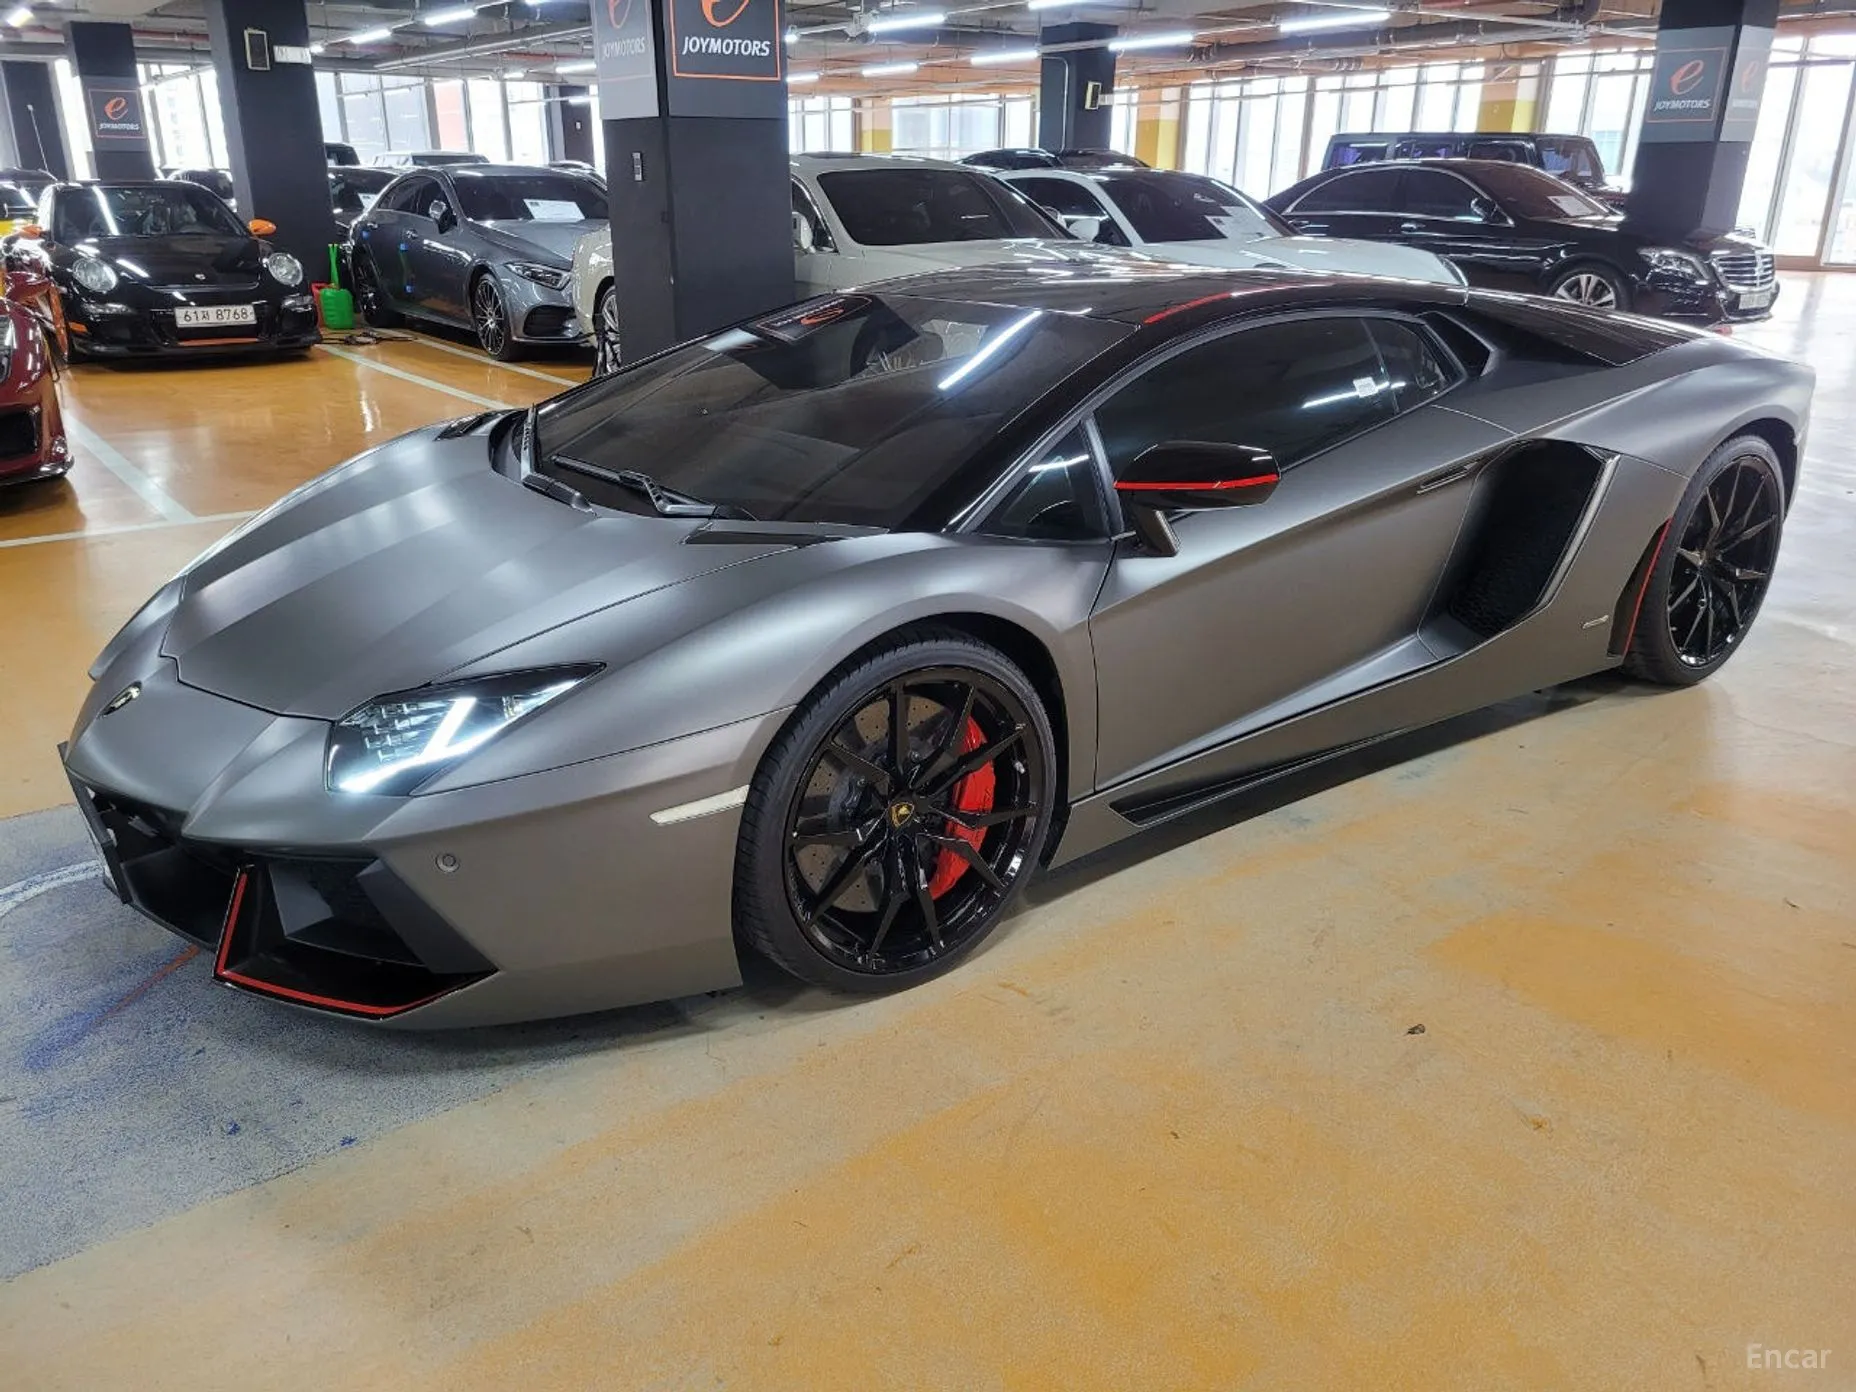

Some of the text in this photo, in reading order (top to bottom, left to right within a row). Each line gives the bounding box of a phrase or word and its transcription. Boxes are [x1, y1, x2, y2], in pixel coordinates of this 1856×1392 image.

[602, 37, 646, 60] JOYMOTORS
[682, 36, 771, 57] JOYMOTORS
[1653, 99, 1712, 112] JOYMOTORS
[216, 307, 248, 321] 8768
